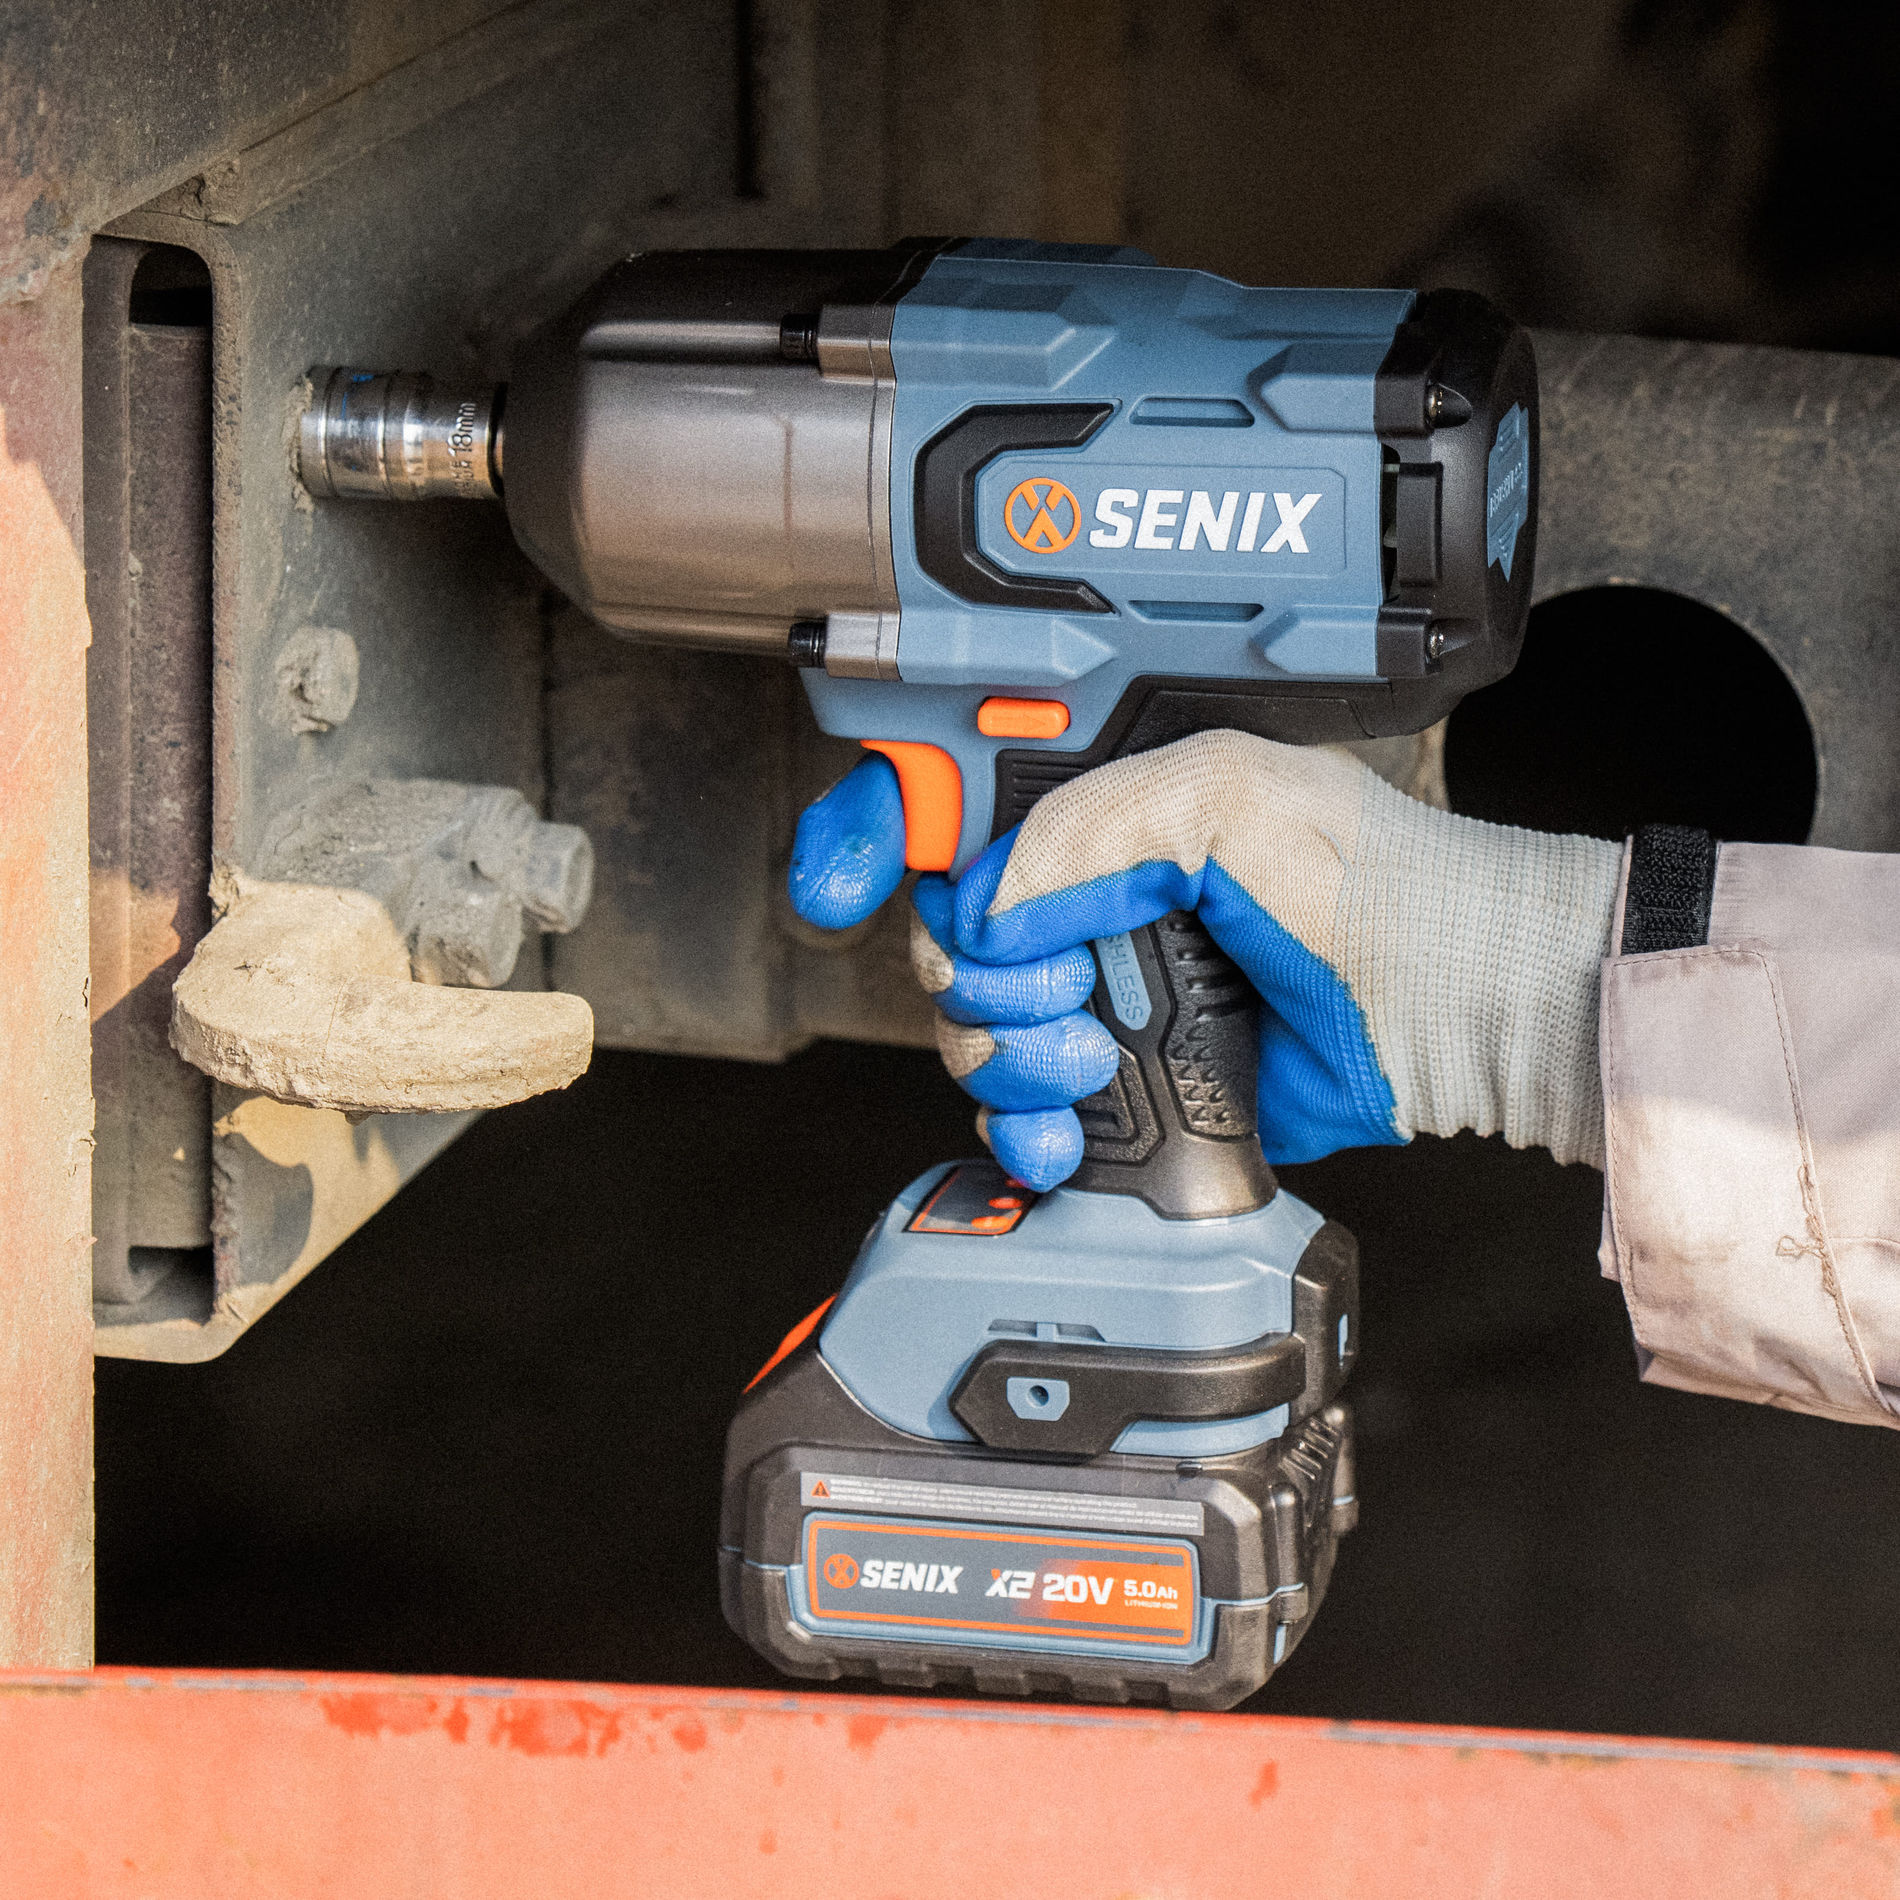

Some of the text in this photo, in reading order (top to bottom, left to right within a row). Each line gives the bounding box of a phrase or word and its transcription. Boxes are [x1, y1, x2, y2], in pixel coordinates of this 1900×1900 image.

[1089, 488, 1322, 554] SENIX
[860, 1559, 1178, 1606] SENIX X2 20V 5.0Ah
